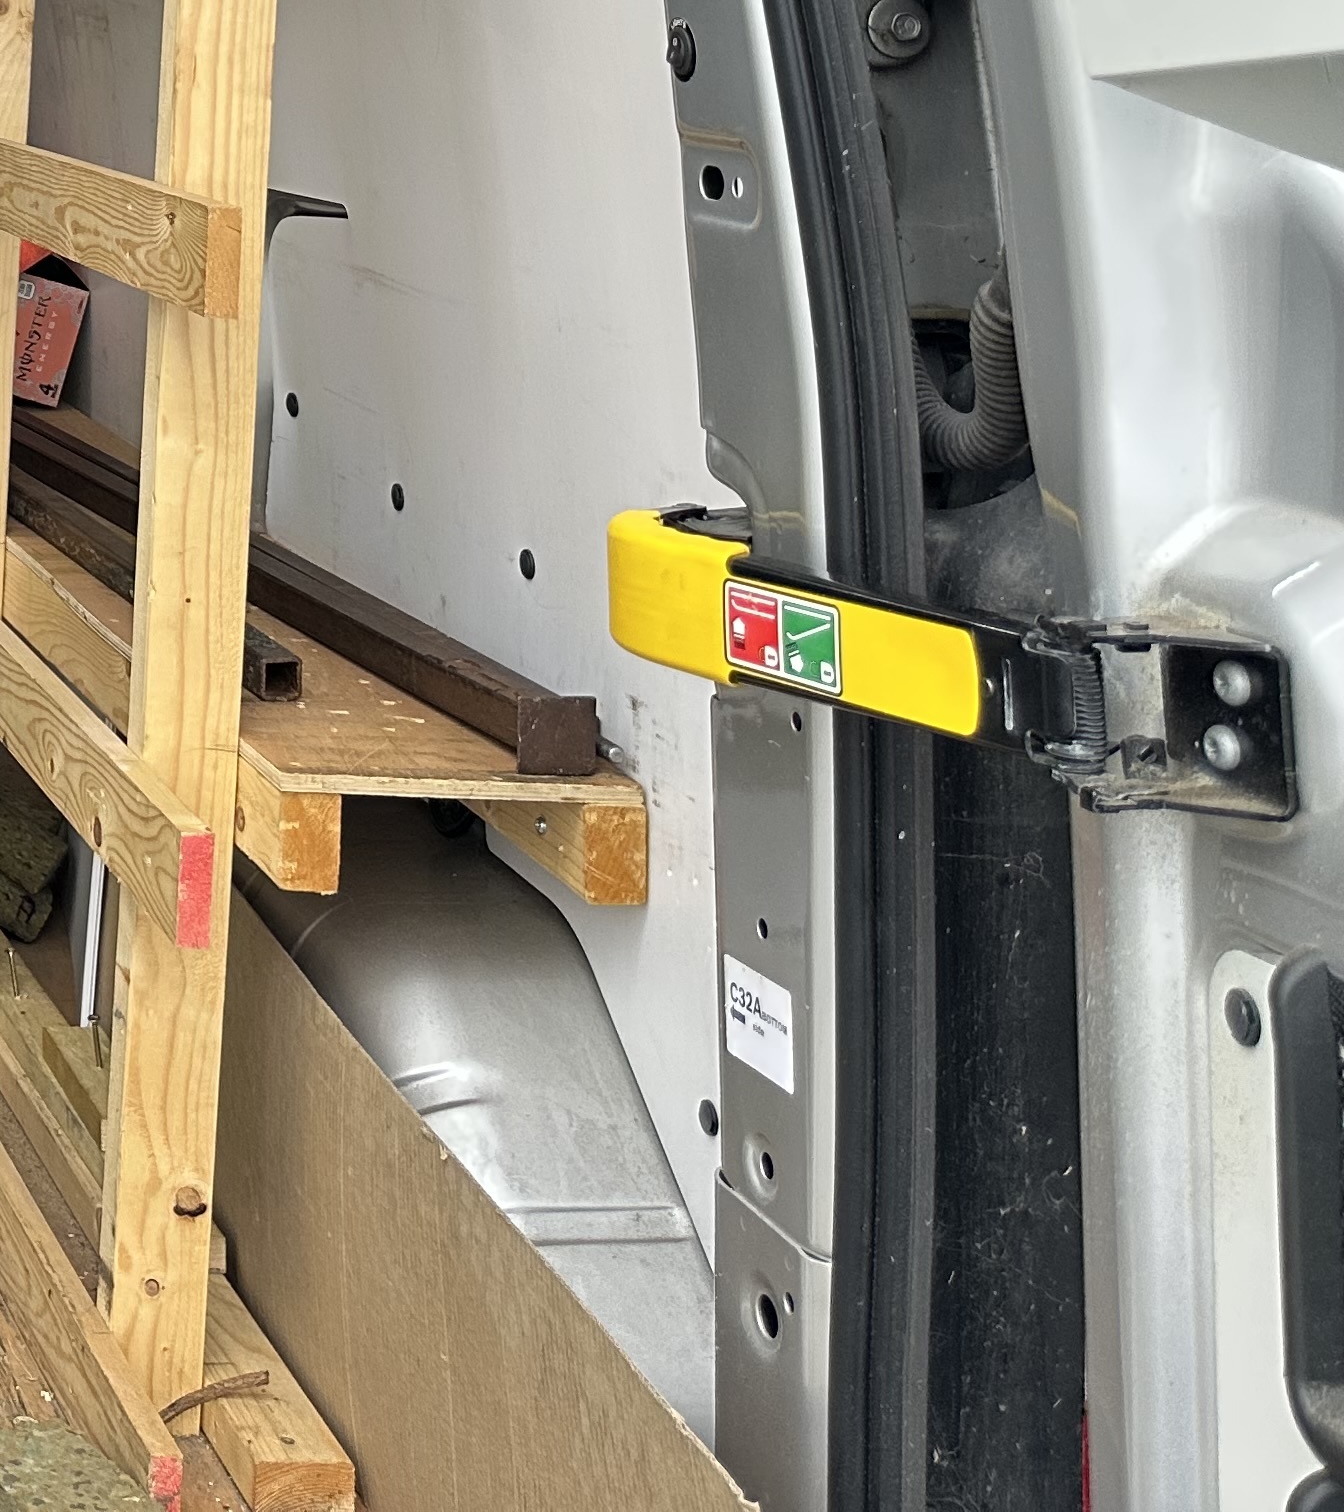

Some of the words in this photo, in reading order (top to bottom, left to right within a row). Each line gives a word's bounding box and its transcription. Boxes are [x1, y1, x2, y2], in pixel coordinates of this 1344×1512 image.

[16, 295, 52, 382] MONSTER
[35, 310, 59, 373] ENERGY
[730, 981, 762, 1021] C32A
